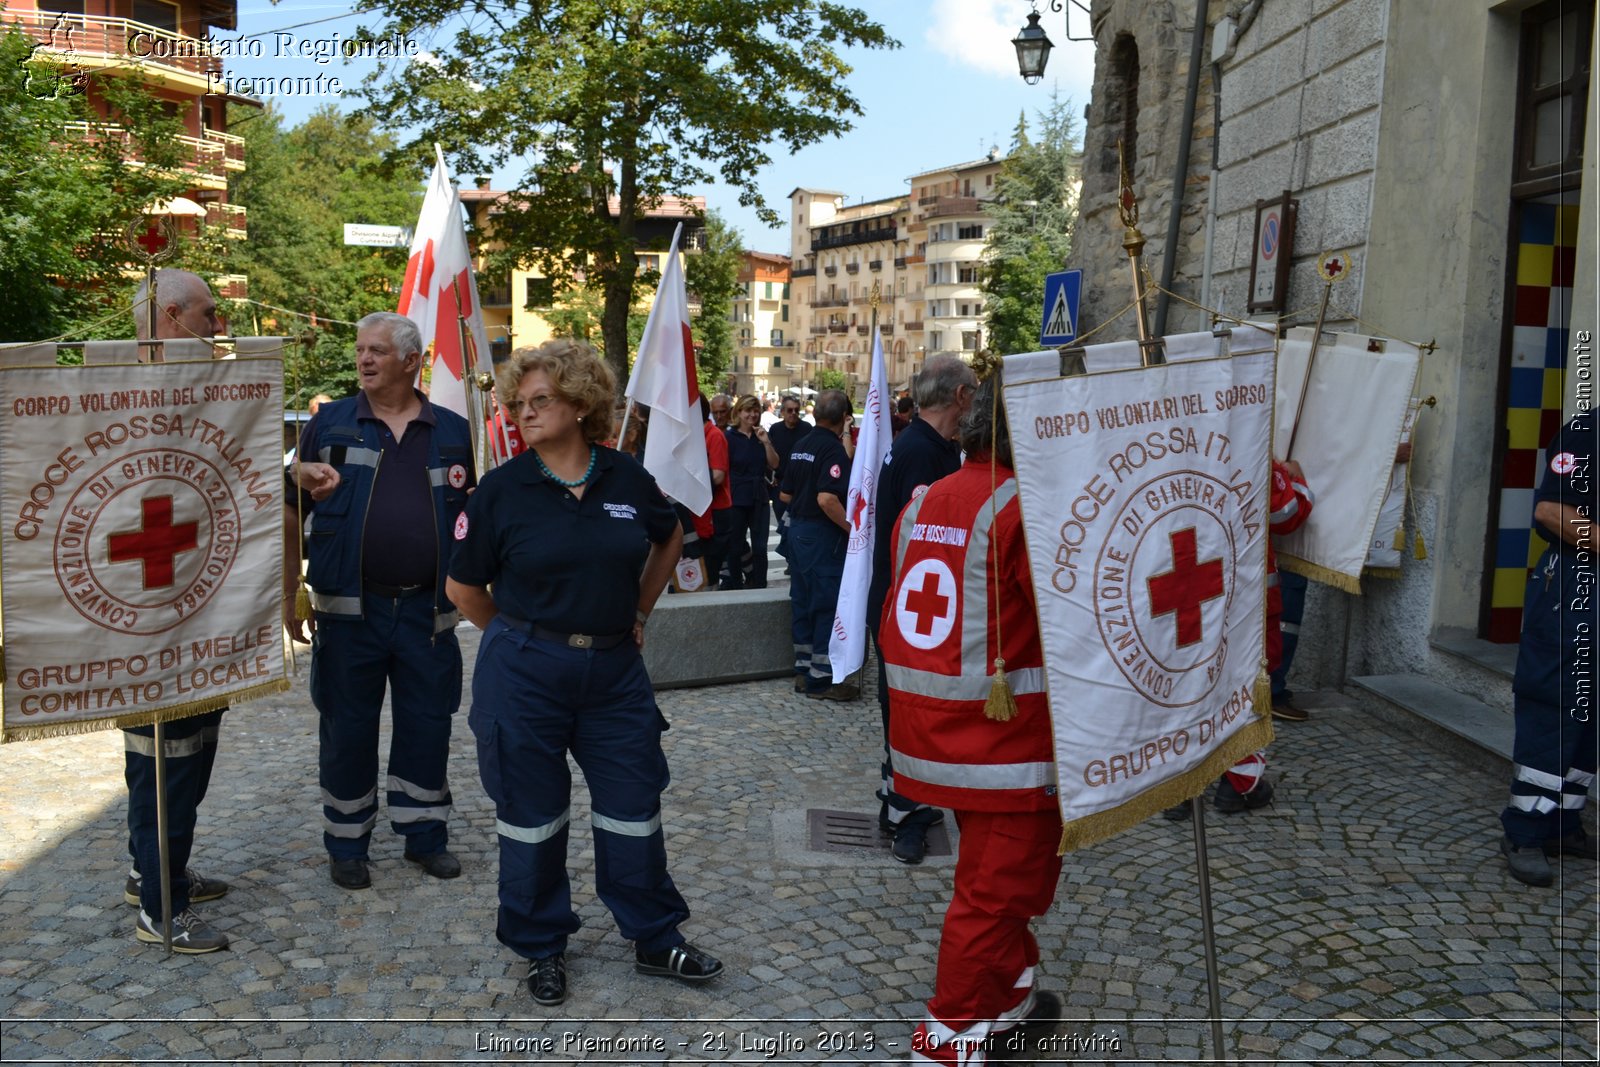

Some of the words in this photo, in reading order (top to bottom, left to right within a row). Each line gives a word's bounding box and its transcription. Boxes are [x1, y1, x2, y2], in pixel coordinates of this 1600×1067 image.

[13, 395, 70, 417] CORPO
[80, 389, 165, 413] VOLONTARI
[173, 387, 198, 406] DEL
[204, 382, 271, 402] SOCCORSO
[1035, 411, 1090, 440] CORPO
[1096, 397, 1178, 430] VOLONTARI
[1182, 393, 1208, 416] DEL
[14, 447, 85, 542] CROCE
[84, 413, 184, 457] ROSSA
[189, 417, 273, 512] ITALIANA
[89, 475, 115, 499] DI
[122, 453, 208, 484] GINEVRA
[205, 480, 227, 505] 22
[1145, 476, 1227, 514] GINEVRA
[1051, 474, 1116, 593] CROCE
[1108, 427, 1199, 483] ROSSA
[1122, 507, 1144, 536] DI
[61, 504, 138, 628] CONVENZIONE
[207, 508, 234, 577] AGOSTO
[174, 578, 214, 618] 1864
[1101, 546, 1173, 699] CONVENZIONE
[17, 654, 148, 691] GRUPPO
[159, 645, 183, 670] DI
[192, 624, 274, 663] MELLE
[20, 681, 164, 716] COMITATO
[177, 654, 270, 694] LOCALE
[1083, 729, 1190, 788] GRUPPO
[1199, 714, 1217, 746] DI
[1220, 684, 1252, 731] ALBA
